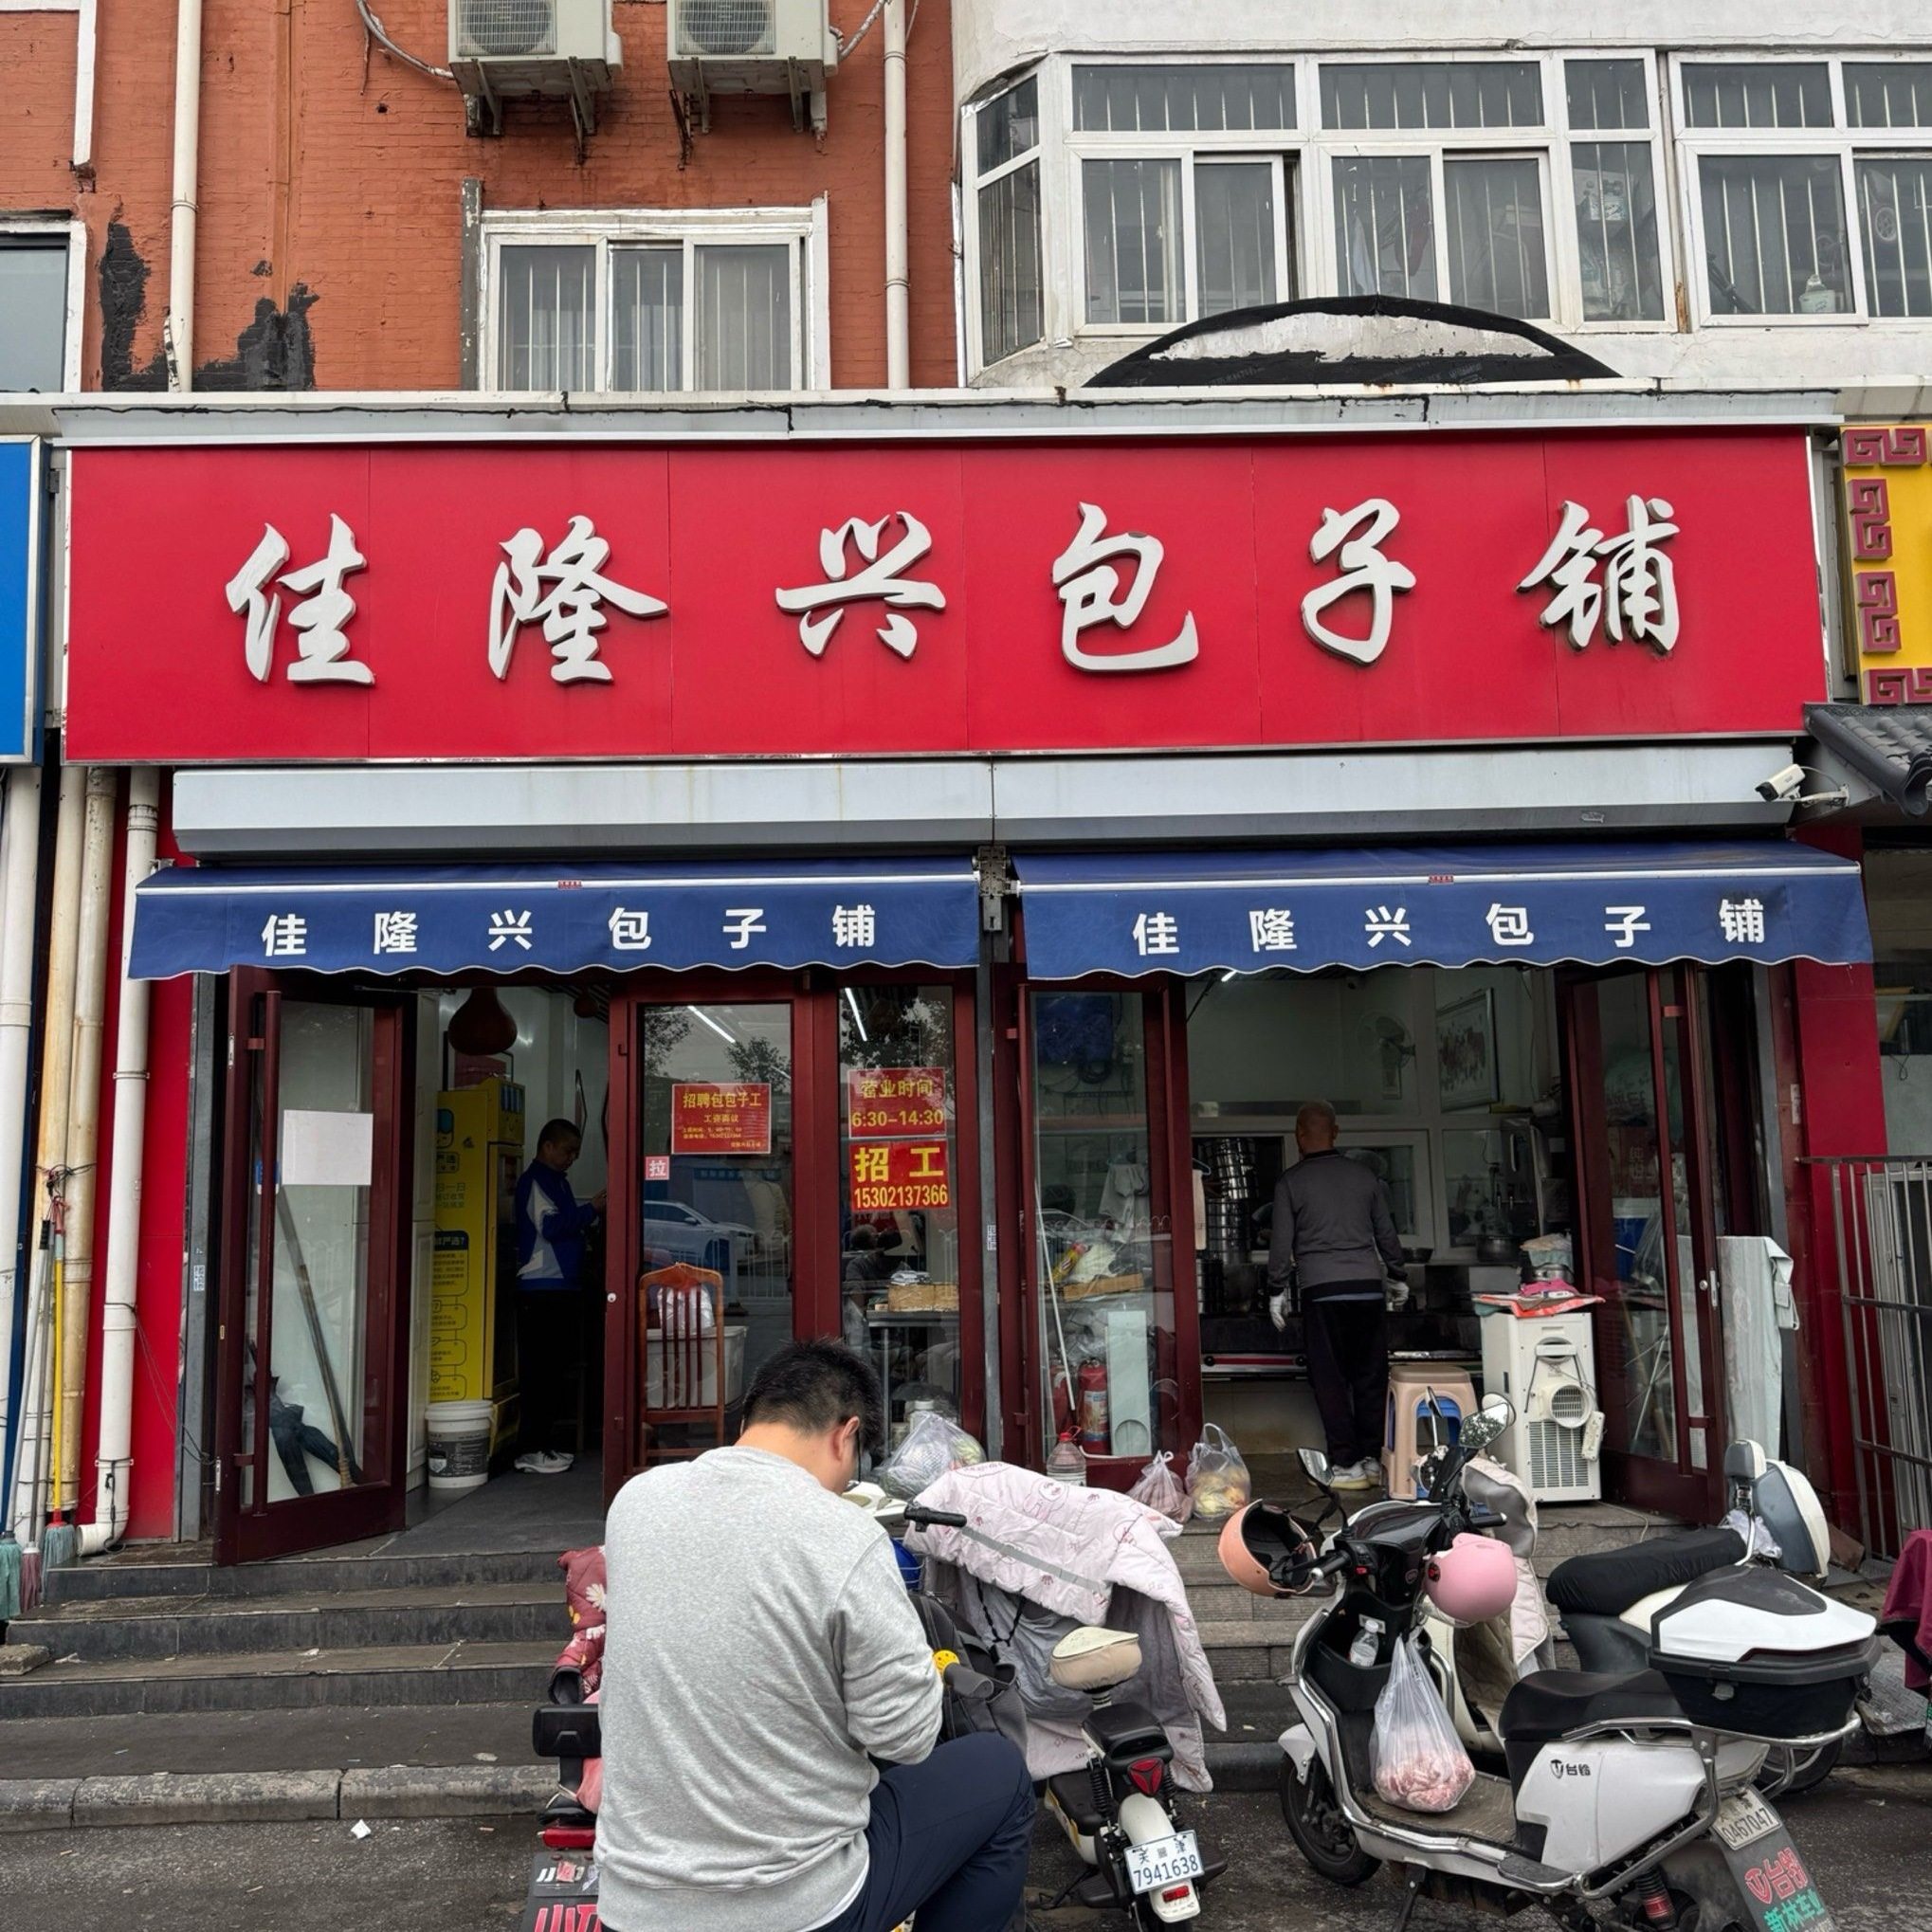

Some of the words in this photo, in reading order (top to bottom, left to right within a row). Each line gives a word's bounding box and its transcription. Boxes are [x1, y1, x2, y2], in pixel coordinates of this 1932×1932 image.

[226, 494, 1680, 685] 佳隆兴包子铺
[261, 903, 876, 957] 佳隆兴包子铺
[1132, 898, 1765, 957] 佳隆兴包子铺
[683, 1092, 762, 1108] 招聘包包子工
[860, 1078, 933, 1099] 营业时间
[649, 1159, 666, 1177] 拉
[854, 1146, 944, 1183] 招工
[854, 1184, 947, 1209] 15302137366
[1722, 1807, 1774, 1844] 0467047
[1133, 1853, 1199, 1888] 7941638
